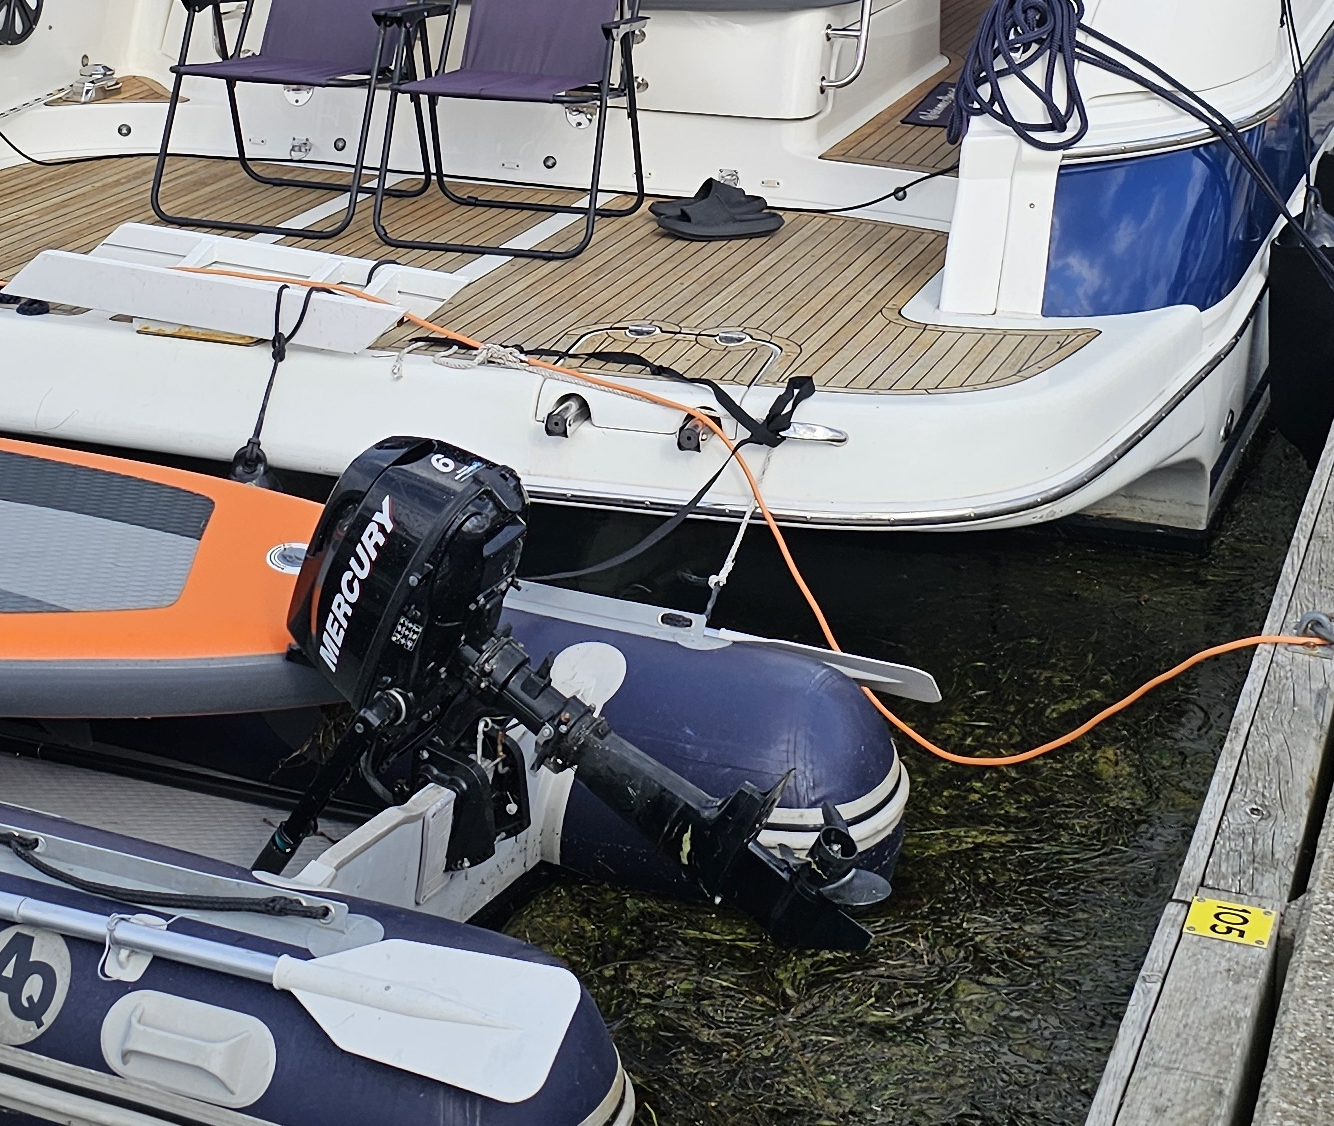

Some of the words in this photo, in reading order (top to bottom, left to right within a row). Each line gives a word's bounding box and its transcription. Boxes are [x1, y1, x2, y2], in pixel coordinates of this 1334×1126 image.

[430, 453, 456, 473] 6
[319, 494, 396, 673] MERCURY
[1209, 905, 1252, 939] 105
